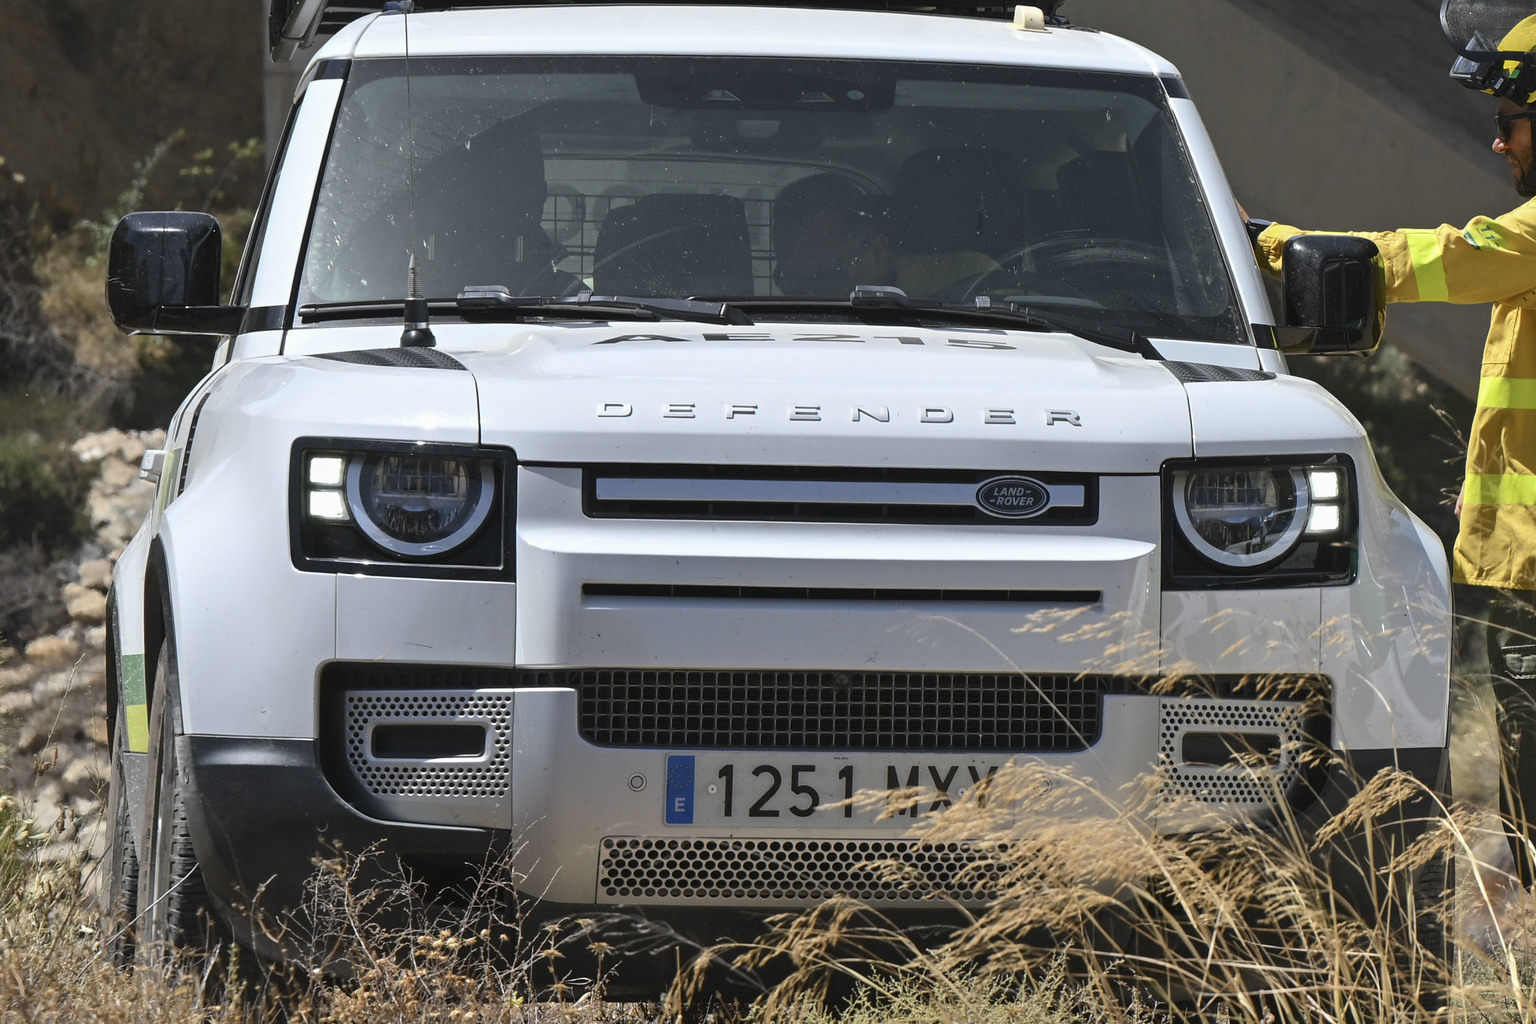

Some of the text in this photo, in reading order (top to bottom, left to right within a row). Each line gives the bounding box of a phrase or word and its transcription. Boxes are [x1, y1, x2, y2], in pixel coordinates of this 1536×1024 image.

[597, 403, 1083, 426] DEFENDER
[674, 797, 686, 812] E
[718, 764, 854, 818] 1251
